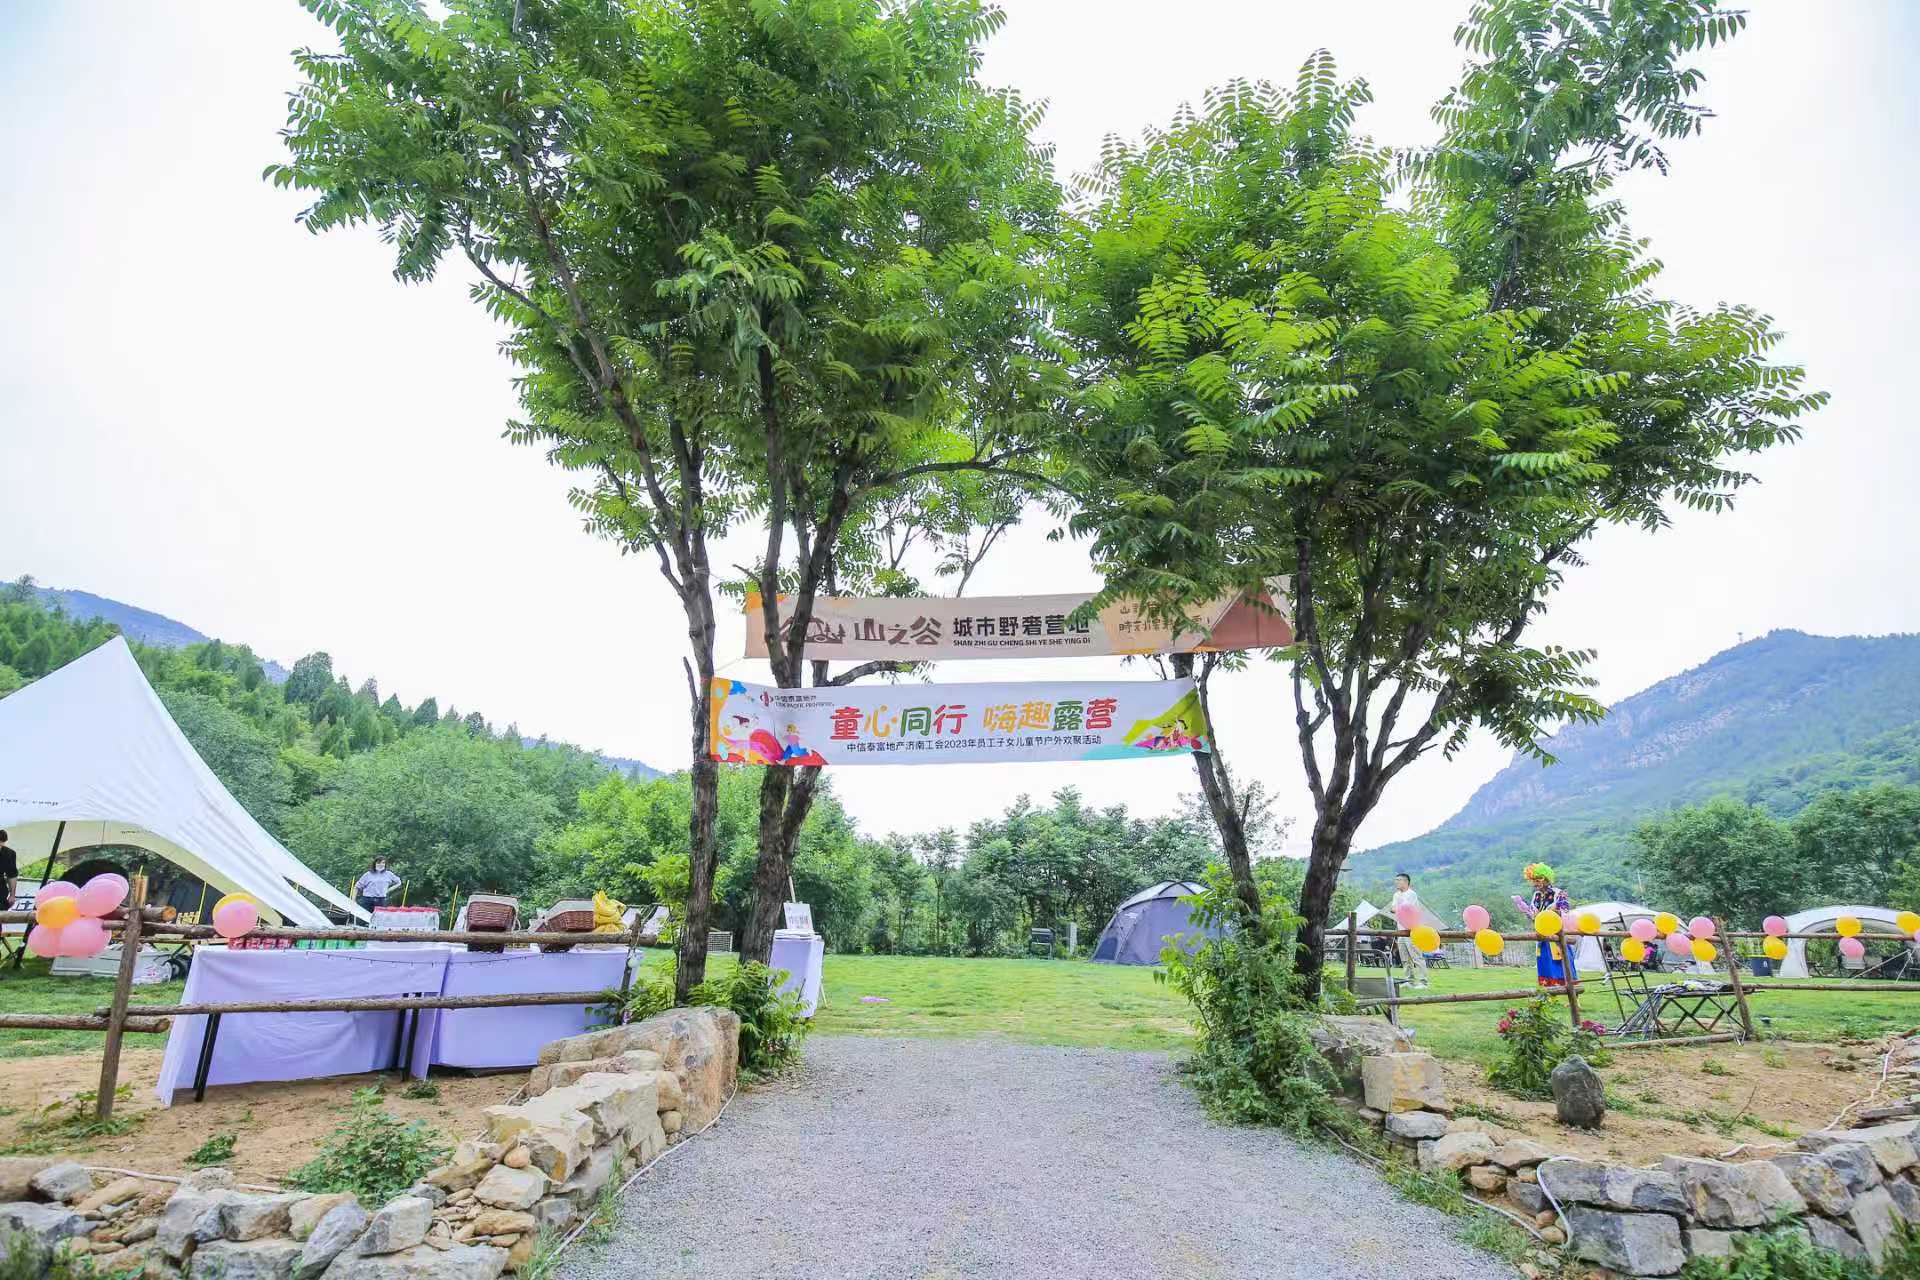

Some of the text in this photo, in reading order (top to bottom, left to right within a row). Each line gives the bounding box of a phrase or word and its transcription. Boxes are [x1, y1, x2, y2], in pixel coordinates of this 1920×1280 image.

[854, 615, 942, 645] 山之谷
[1064, 637, 1082, 645] YING
[830, 698, 1118, 740] 童心同行 嗨趣露营
